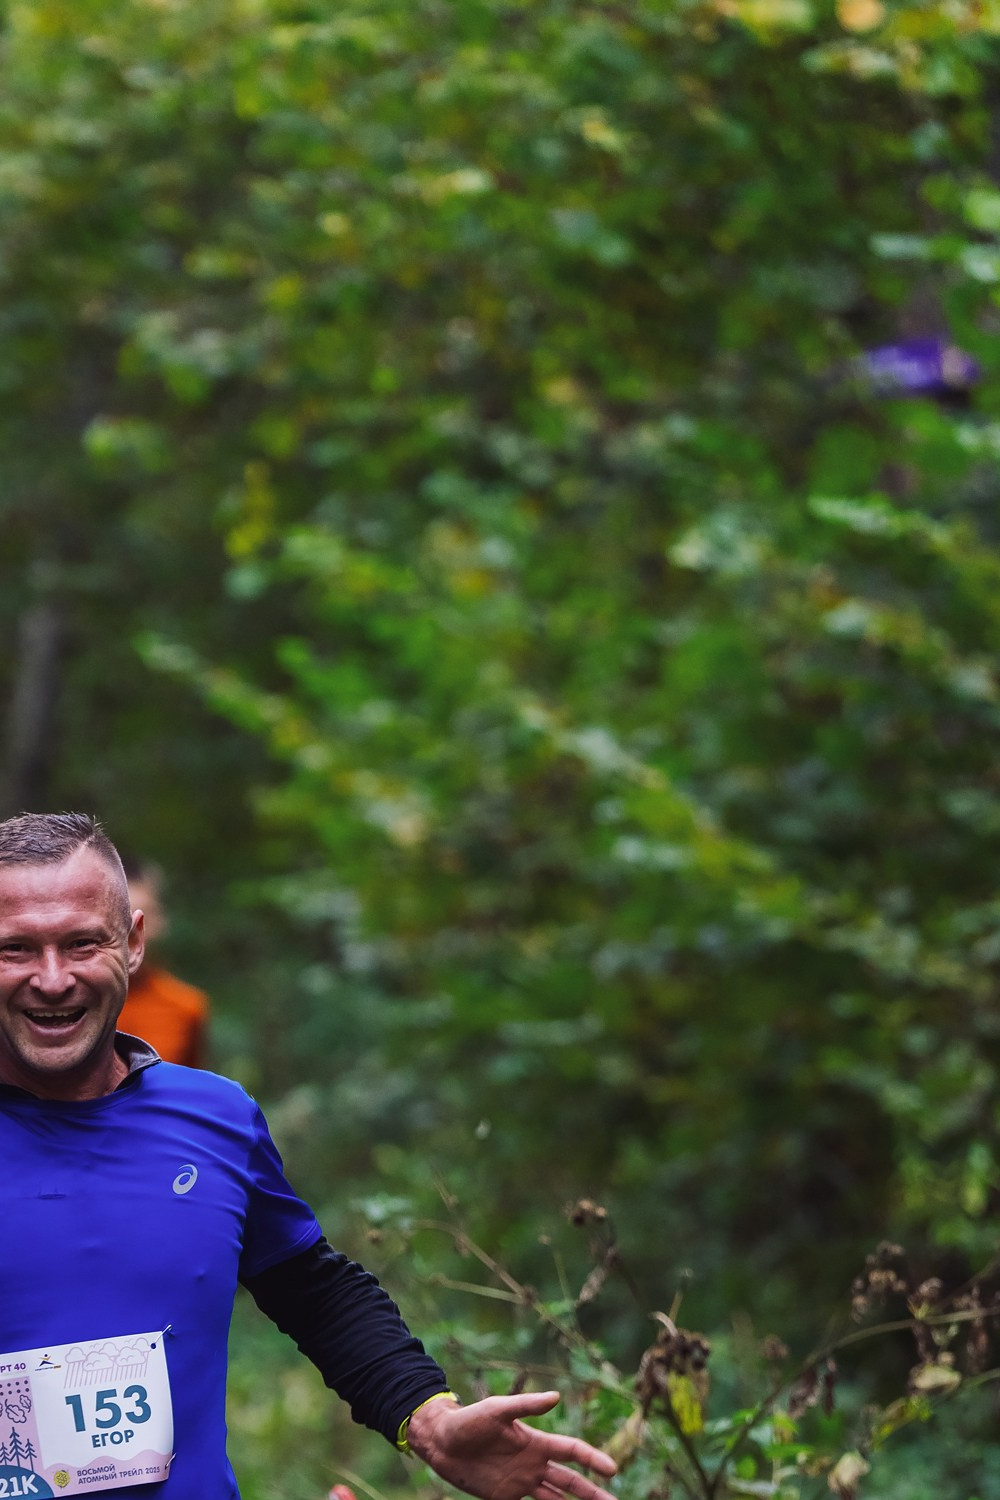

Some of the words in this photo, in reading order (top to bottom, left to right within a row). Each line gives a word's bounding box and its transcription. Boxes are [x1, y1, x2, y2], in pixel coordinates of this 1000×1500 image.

[14, 1362, 27, 1371] 40
[64, 1384, 152, 1433] 153
[91, 1429, 135, 1448] ЕГОР
[77, 1464, 116, 1477] ВОСЬМОЙ
[78, 1472, 117, 1485] АТОМНЫЙ
[119, 1468, 143, 1478] ТРЕЙЛ
[145, 1466, 160, 1475] 2025
